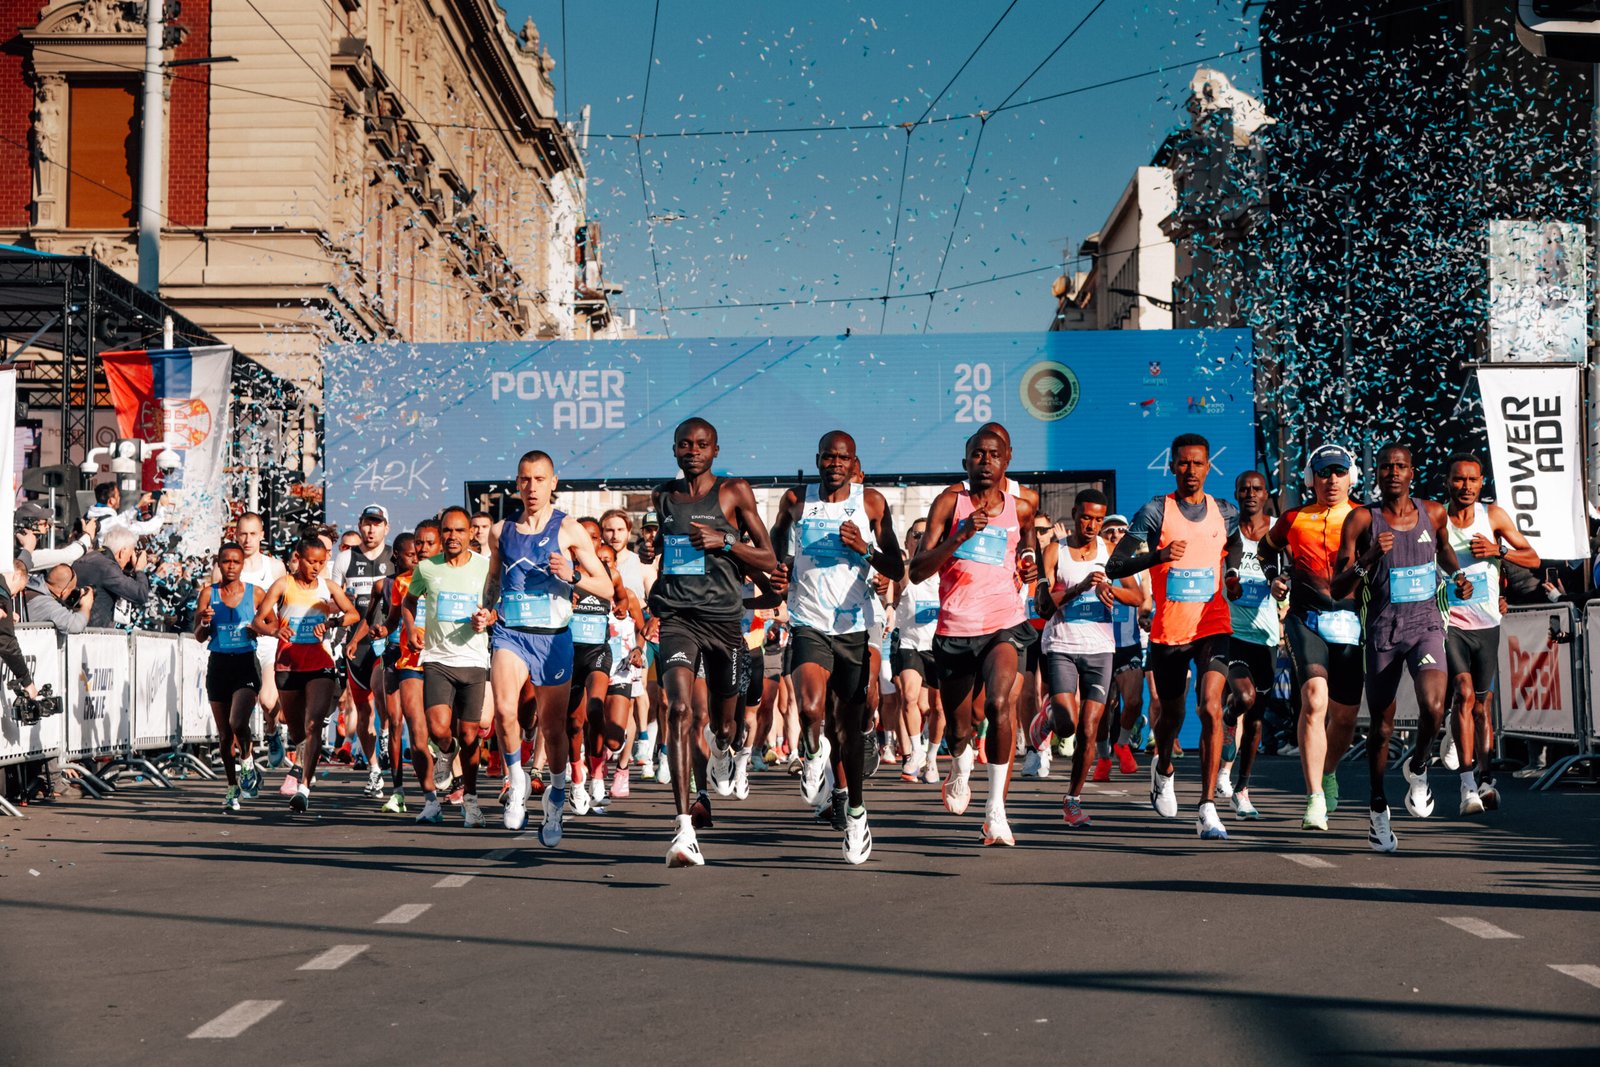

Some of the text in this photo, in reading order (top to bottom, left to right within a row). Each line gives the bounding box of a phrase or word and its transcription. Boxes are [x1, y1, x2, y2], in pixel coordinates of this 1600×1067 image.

[491, 370, 625, 400] POWER
[954, 363, 992, 391] 20
[553, 400, 625, 429] ADE
[955, 394, 993, 423] 26
[1533, 396, 1565, 472] ADE
[354, 458, 434, 491] 42K
[1147, 447, 1228, 477] 4K
[1501, 396, 1541, 538] POWER
[675, 548, 682, 558] 11
[1411, 578, 1421, 587] 12
[520, 602, 530, 610] 13
[1508, 636, 1562, 711] Persil
